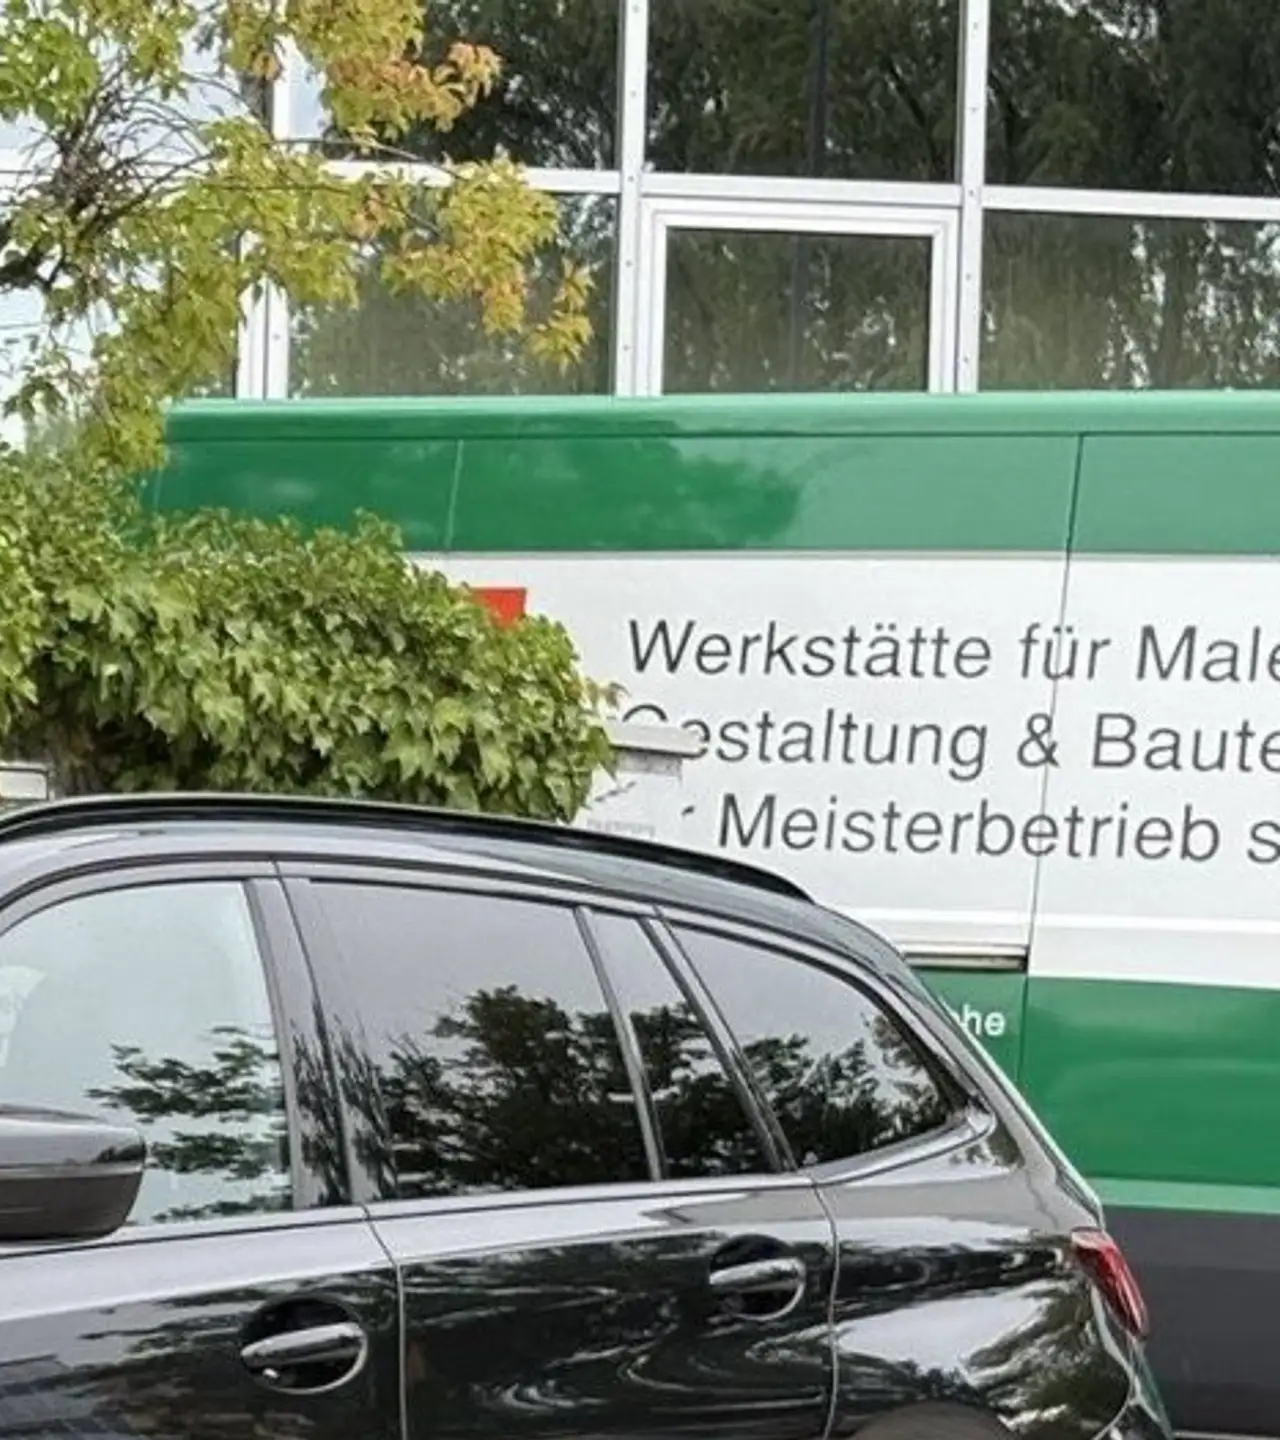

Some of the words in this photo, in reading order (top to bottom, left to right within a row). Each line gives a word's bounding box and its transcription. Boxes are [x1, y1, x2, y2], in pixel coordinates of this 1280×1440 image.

[628, 620, 992, 680] Werkstätte
[1019, 621, 1111, 681] für
[622, 703, 988, 781] estaltung
[1016, 713, 1060, 768] &
[717, 792, 1221, 863] Meisterbetrieb
